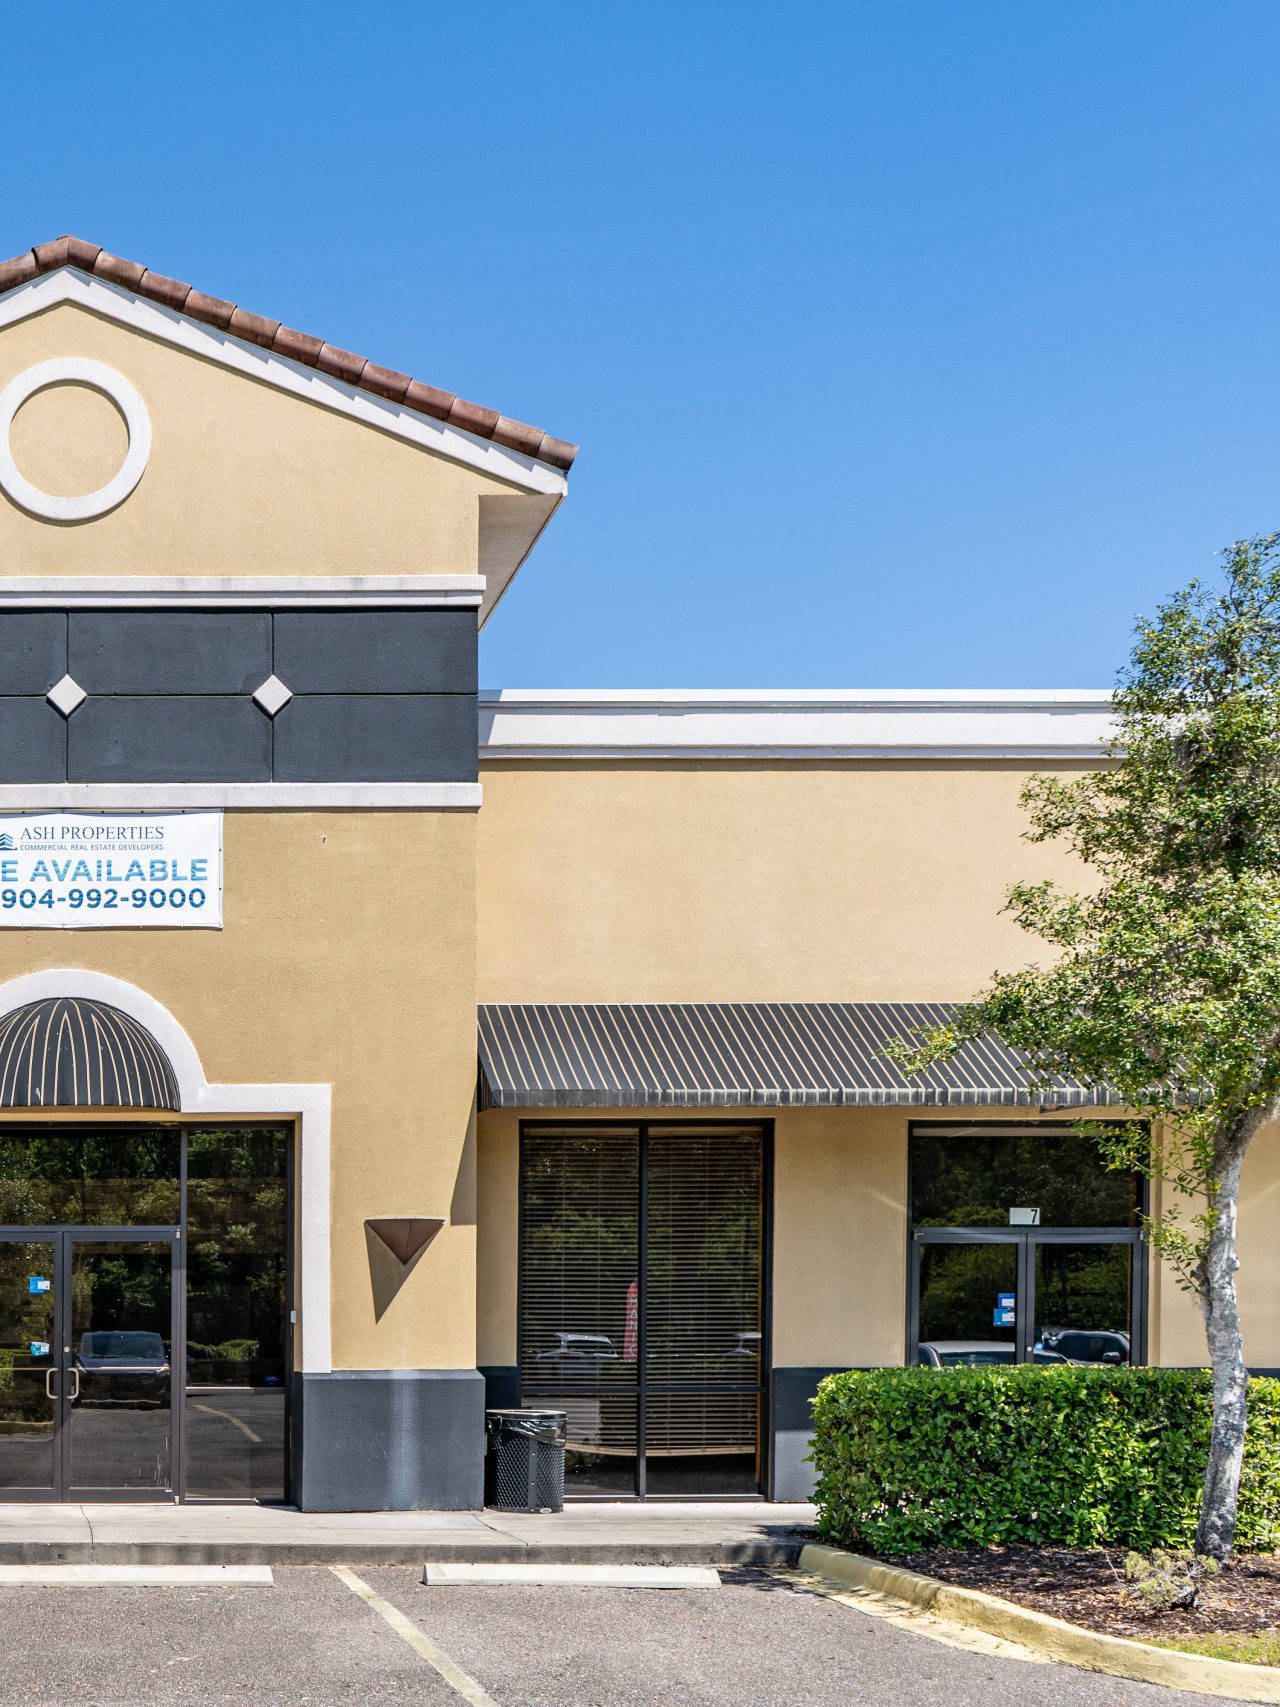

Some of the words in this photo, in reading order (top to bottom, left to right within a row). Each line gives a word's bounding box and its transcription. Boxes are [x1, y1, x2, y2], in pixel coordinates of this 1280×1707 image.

[20, 825, 55, 840] ASH
[61, 825, 164, 840] PROPERTIES
[30, 858, 208, 882] AVAILABLE
[1, 888, 206, 909] 904-992-9000
[1030, 1209, 1038, 1224] 7
